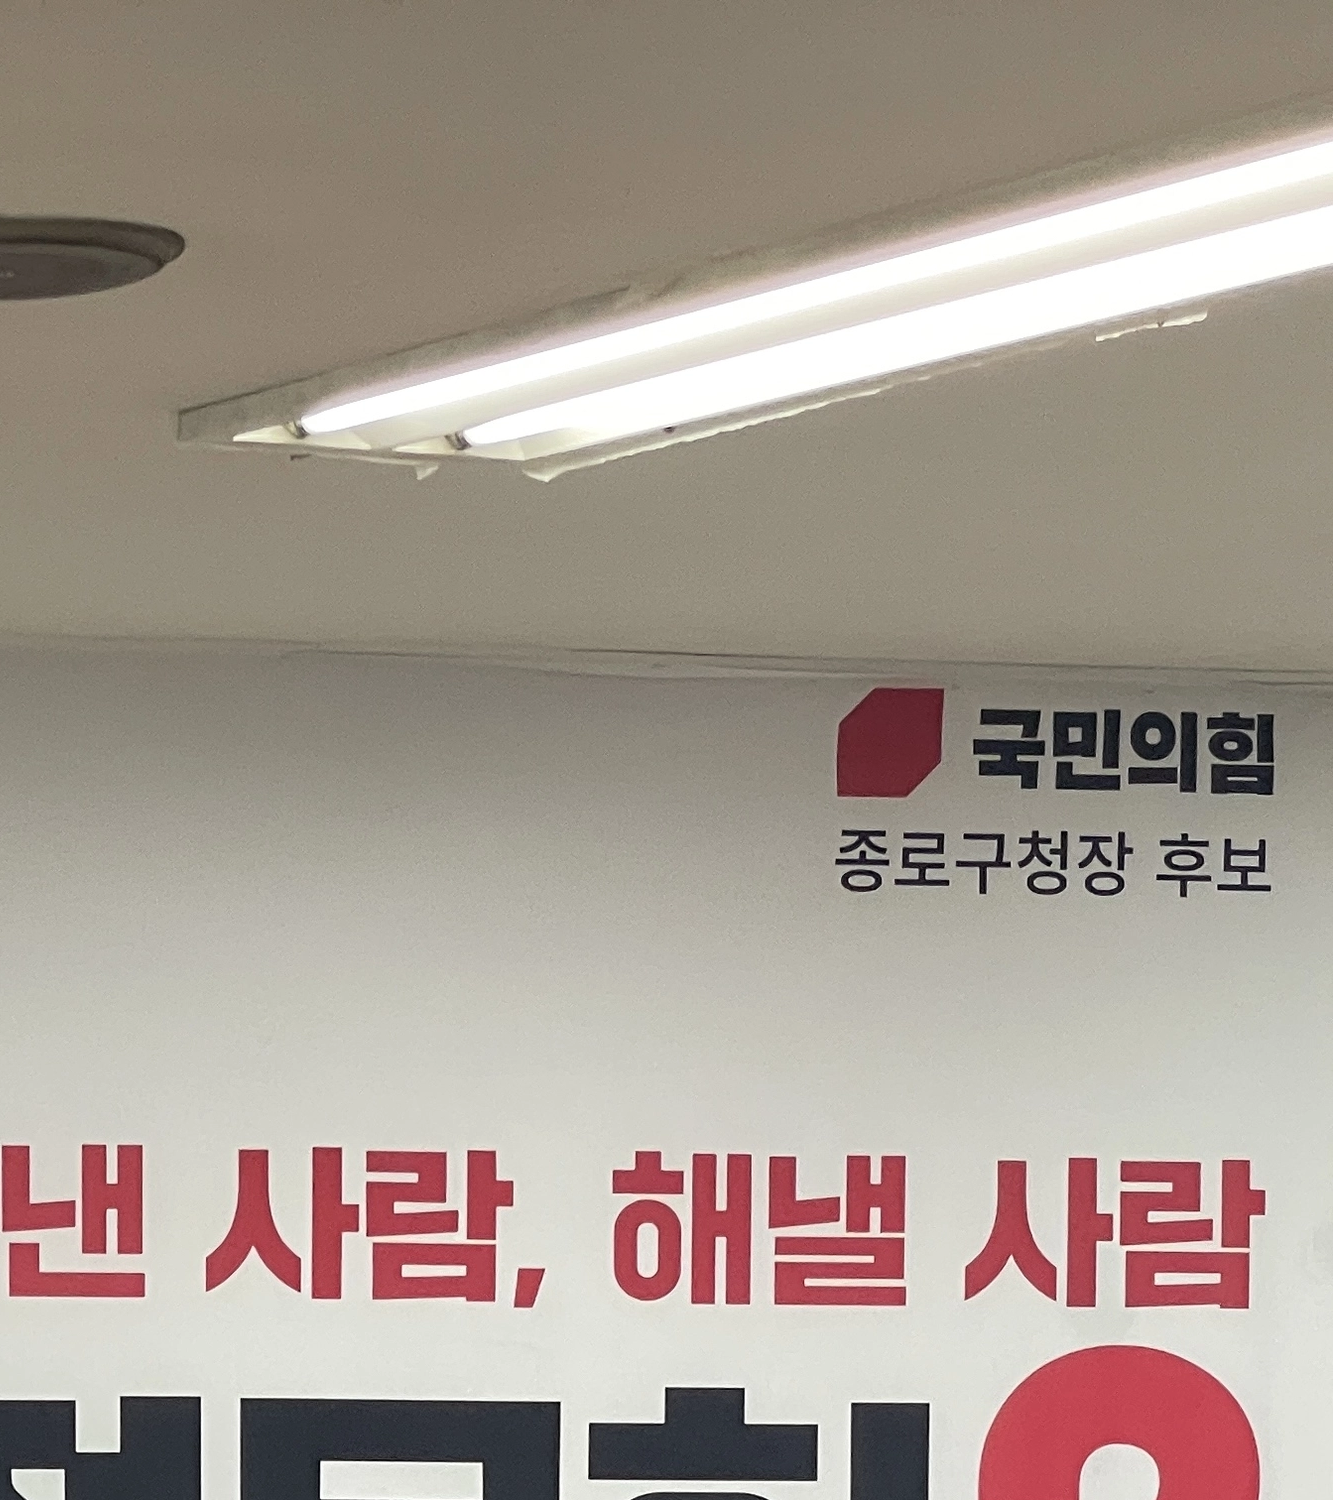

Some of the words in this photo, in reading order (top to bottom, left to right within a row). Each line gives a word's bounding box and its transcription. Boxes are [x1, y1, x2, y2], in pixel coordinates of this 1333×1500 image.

[972, 708, 1275, 796] 국민의힘
[834, 829, 1134, 897] 종로구청장
[1155, 832, 1273, 898] 후보
[204, 1146, 547, 1310] 사람,
[611, 1150, 907, 1307] 해낼
[964, 1156, 1267, 1310] 사람
